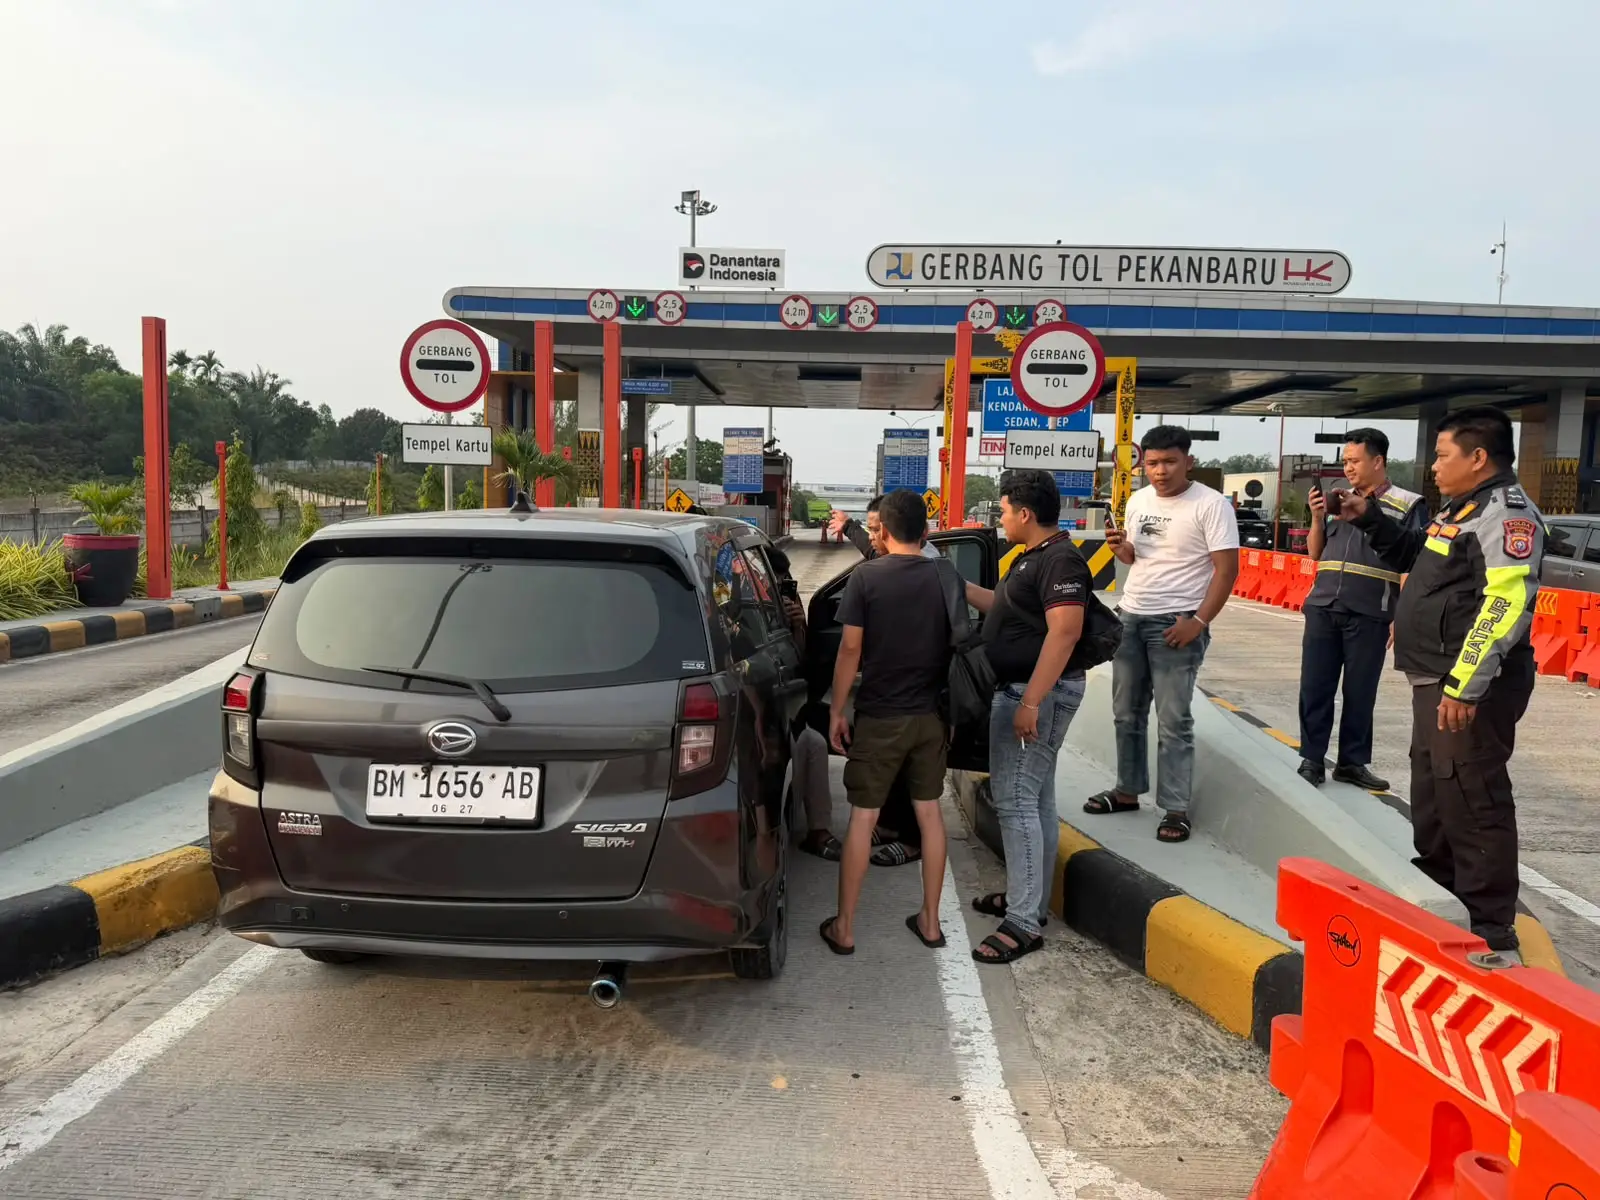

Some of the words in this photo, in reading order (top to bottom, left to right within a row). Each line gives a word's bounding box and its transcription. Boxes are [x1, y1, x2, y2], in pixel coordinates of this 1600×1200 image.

[709, 253, 781, 268] Danantara
[709, 267, 777, 282] Indonesia
[921, 252, 1044, 281] GERBANG
[1057, 253, 1103, 282] TOL
[1117, 254, 1277, 286] PEKANBARU
[418, 344, 472, 358] GERBANG
[1030, 349, 1086, 361] GERBANG
[434, 373, 457, 384] TOL
[1045, 377, 1069, 388] TOL
[997, 386, 1015, 396] LAJ
[1004, 416, 1041, 429] SEDAN,
[1045, 416, 1069, 428] JEP
[405, 436, 450, 455] Tempel
[455, 438, 489, 453] Kartu
[982, 441, 1005, 453] TIN
[1009, 442, 1055, 460] Tempel
[1060, 444, 1095, 459] Kartu
[1461, 596, 1512, 666] SATPJR
[372, 769, 405, 798] BM
[419, 769, 485, 799] 1656
[501, 771, 534, 800] AB
[431, 803, 447, 814] 06
[459, 804, 473, 814] 27
[279, 811, 321, 825] ASTRA
[571, 822, 648, 834] SIGRA
